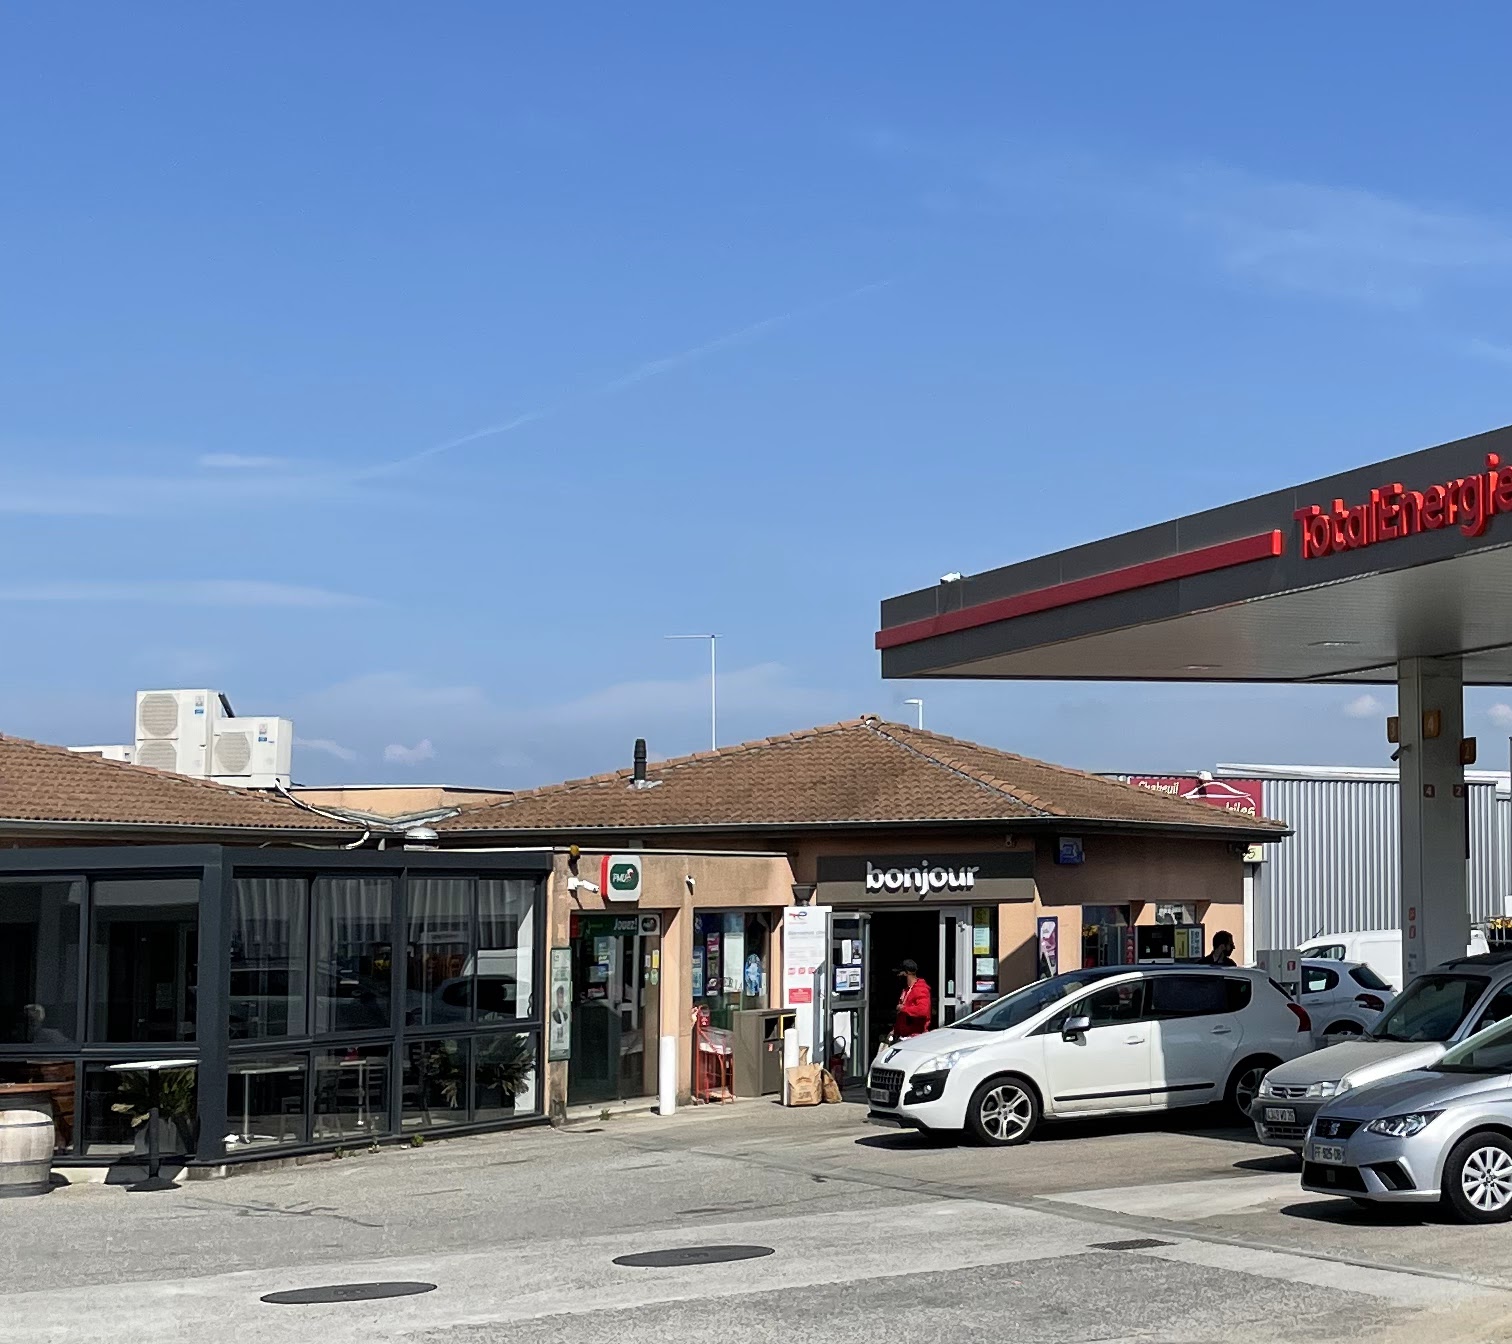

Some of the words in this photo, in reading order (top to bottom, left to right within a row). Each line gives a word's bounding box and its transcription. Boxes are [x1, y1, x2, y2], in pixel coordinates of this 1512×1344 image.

[1425, 786, 1433, 795] 4
[612, 872, 628, 883] PMU
[866, 860, 980, 895] bonjour
